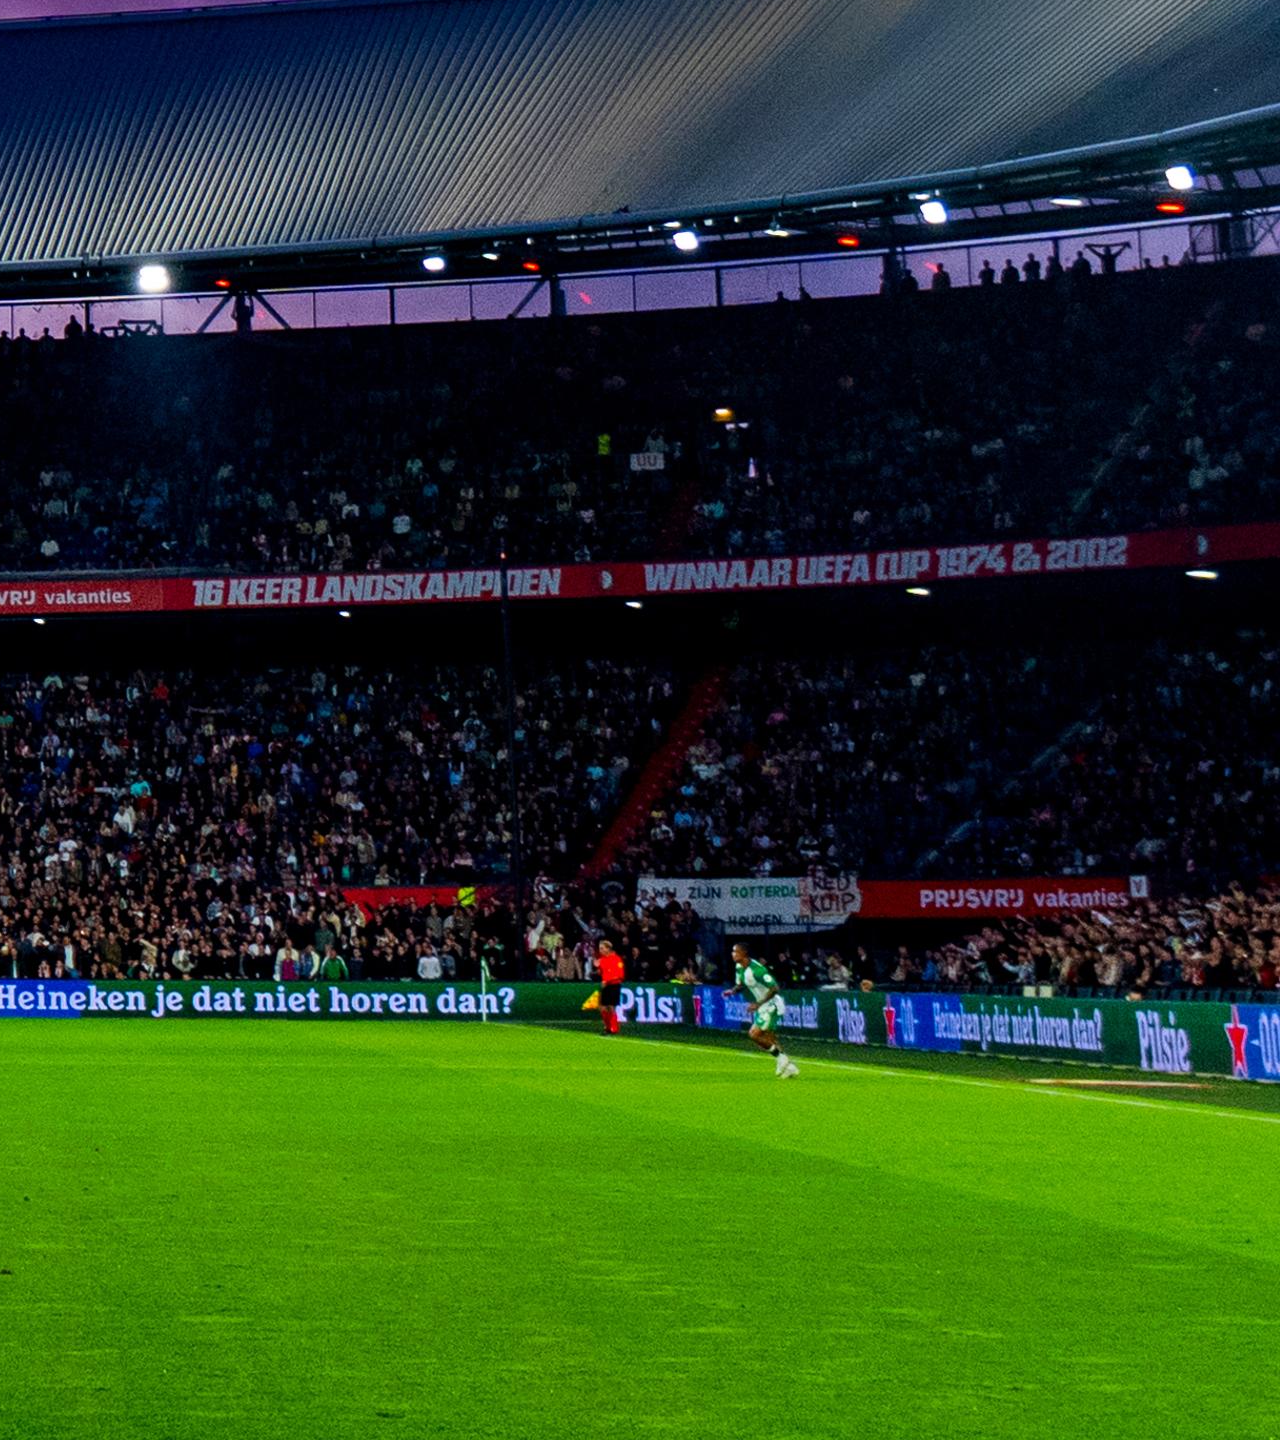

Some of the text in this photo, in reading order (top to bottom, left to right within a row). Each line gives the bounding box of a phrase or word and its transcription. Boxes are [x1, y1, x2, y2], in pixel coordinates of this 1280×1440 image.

[643, 535, 1129, 592] WINNAAR UEFA CUP 1974 & 2002
[43, 588, 132, 605] vakanties
[191, 579, 225, 607] 16
[227, 578, 303, 606] KEER
[687, 886, 722, 900] ZIJN
[730, 885, 797, 898] ROTTERDA
[1032, 888, 1129, 908] vakanties
[151, 984, 184, 1018] je
[192, 985, 246, 1012] dat
[253, 985, 321, 1013] niet
[328, 986, 430, 1015] horen
[436, 987, 517, 1015] dan?
[615, 986, 684, 1024] Pils
[1034, 1005, 1070, 1049] horen
[1135, 1009, 1192, 1073] Pilsie
